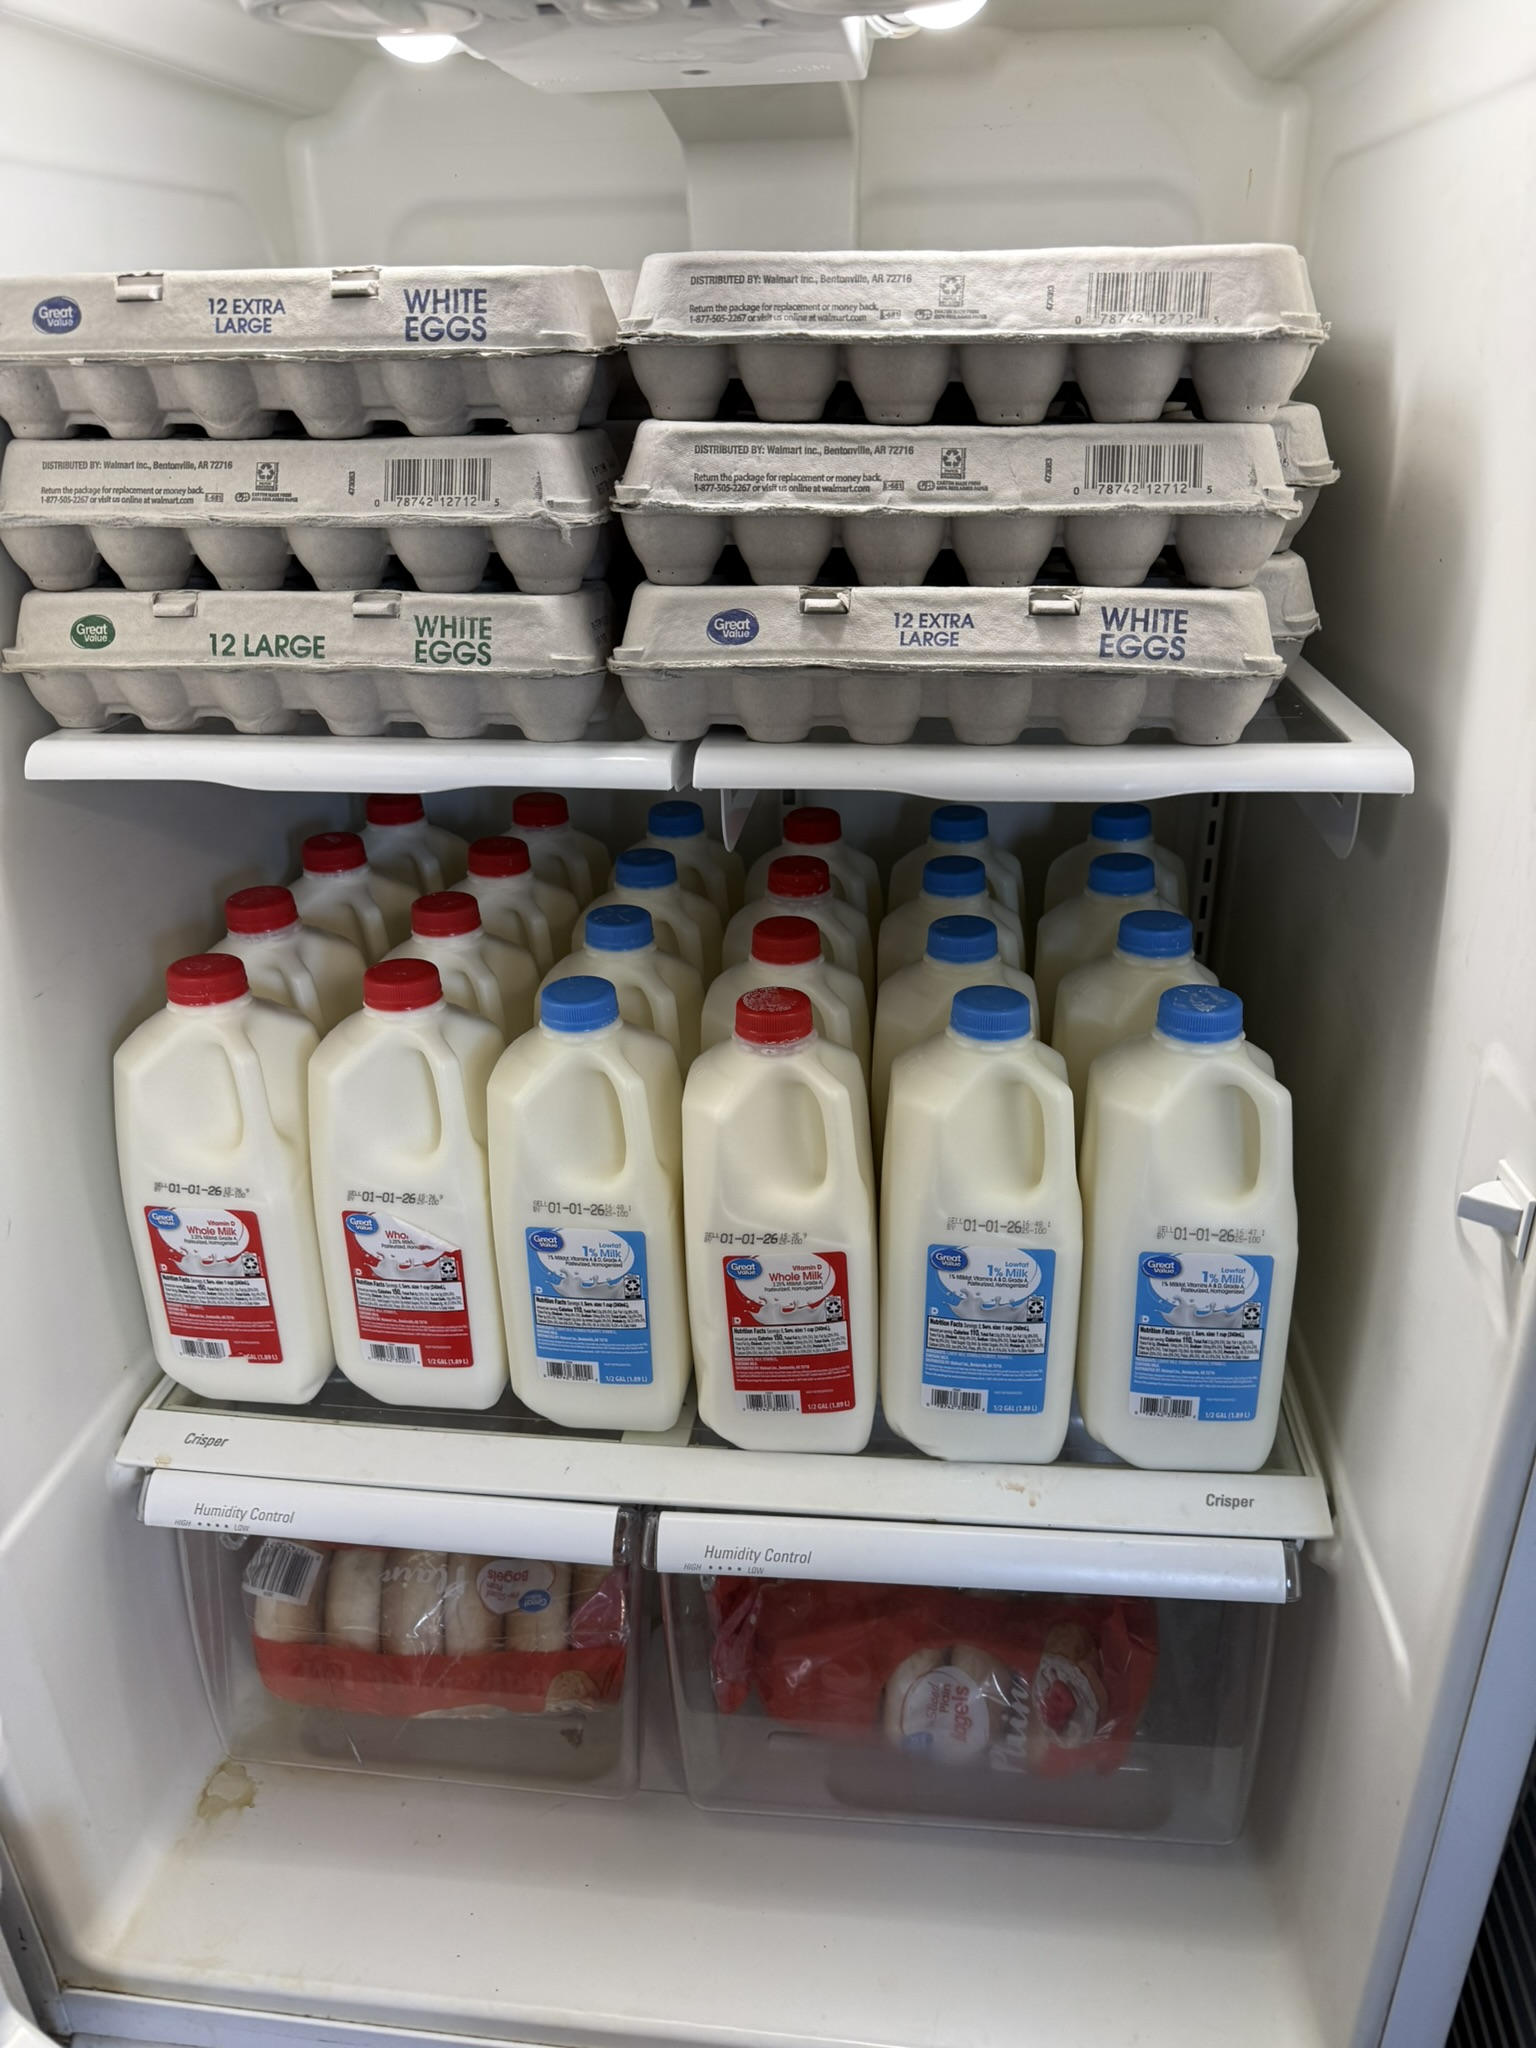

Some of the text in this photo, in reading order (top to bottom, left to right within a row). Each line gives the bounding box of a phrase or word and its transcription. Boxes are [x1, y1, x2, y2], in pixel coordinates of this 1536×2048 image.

[690, 276, 746, 286] DISTRIBUTED
[746, 275, 761, 284] BY:
[763, 274, 798, 284] Walmart
[820, 274, 870, 285] Bentonville,
[871, 274, 884, 284] AR
[885, 274, 912, 284] 72716
[208, 298, 286, 315] 12 EXTRA
[403, 288, 488, 314] WHITE
[38, 306, 74, 319] Great
[689, 304, 714, 313] Return
[715, 303, 728, 312] the
[729, 304, 760, 315] package
[761, 303, 772, 312] for
[774, 303, 820, 314] replacement
[822, 304, 830, 312] or
[832, 304, 858, 314] money
[47, 318, 74, 328] Value
[690, 314, 746, 324] 1-877-505-2267
[748, 314, 756, 322] or
[757, 313, 772, 322] visit
[774, 314, 782, 322] us
[784, 313, 807, 322] online
[808, 314, 816, 322] at
[818, 313, 867, 322] walmart.com
[1074, 314, 1220, 325] 0 78742 12712 5
[215, 318, 272, 334] LARGE
[404, 316, 487, 342] EGGS
[694, 444, 750, 454] DISTRIBUTED
[750, 445, 765, 454] BY:
[767, 445, 802, 454] Walmart
[824, 446, 873, 456] Bentonville,
[874, 446, 886, 454] AR
[888, 446, 914, 455] 72716
[42, 460, 88, 470] DISTRIBUTED
[89, 461, 102, 470] BY:
[103, 461, 135, 470] Walmart
[152, 461, 196, 471] Bentonville,
[198, 461, 208, 470] AR
[210, 460, 232, 470] 72716
[694, 473, 719, 482] Return
[720, 473, 732, 482] the
[734, 473, 765, 484] package
[766, 473, 777, 482] for
[778, 473, 824, 484] replacement
[835, 474, 861, 484] money
[41, 486, 62, 494] Return
[62, 486, 74, 494] the
[74, 486, 101, 497] package
[102, 486, 112, 495] for
[113, 486, 154, 497] replacement
[164, 488, 186, 497] money
[694, 483, 870, 492] 1-877-505-2267 or visit us online at walmart.com
[1073, 483, 1212, 496] 0 78742 12712 5
[41, 496, 89, 504] 1-877-505-2267
[98, 496, 112, 504] visit
[121, 496, 142, 504] online
[144, 496, 150, 504] at
[151, 496, 194, 504] walmart.com
[374, 497, 500, 508] 0 78742 12712 5
[714, 618, 750, 630] Great
[894, 612, 975, 629] 12 EXTRA
[1100, 606, 1189, 634] WHITE
[76, 624, 108, 636] Great
[414, 615, 492, 640] WHITE
[722, 628, 750, 638] Value
[84, 634, 108, 642] Value
[900, 631, 960, 647] LARGE
[209, 633, 326, 659] 12 LARGE
[1100, 633, 1186, 662] EGGS
[414, 640, 492, 666] EGGS
[168, 1182, 222, 1196] 01-01-26
[362, 1191, 416, 1204] 01-01-26
[548, 1202, 605, 1216] 01-01-26
[152, 1214, 174, 1222] Great
[350, 1218, 372, 1227] Great
[186, 1226, 238, 1236] Whole Milk
[963, 1218, 1022, 1234] 01-01-26
[385, 1230, 409, 1240] Who
[534, 1234, 558, 1244] Great
[720, 1232, 778, 1246] 01-01-26
[1174, 1226, 1235, 1242] 01-01-26
[582, 1246, 622, 1258] 1% Milk
[935, 1253, 962, 1262] Great
[730, 1263, 756, 1272] Great
[792, 1264, 816, 1272] Vitamin
[1147, 1260, 1175, 1270] Great
[768, 1270, 824, 1282] Whole Milk
[986, 1265, 1028, 1278] 1% Milk
[1202, 1270, 1245, 1284] 1% Milk
[184, 1432, 229, 1448] Crisper
[1206, 1493, 1255, 1510] Crisper
[194, 1502, 296, 1524] Humidity Control
[174, 1519, 250, 1532] HIGH LOW
[704, 1544, 812, 1564] Humidity Control
[488, 1569, 529, 1583] Bagels
[747, 1566, 764, 1574] LOW
[939, 1684, 951, 1714] Plain
